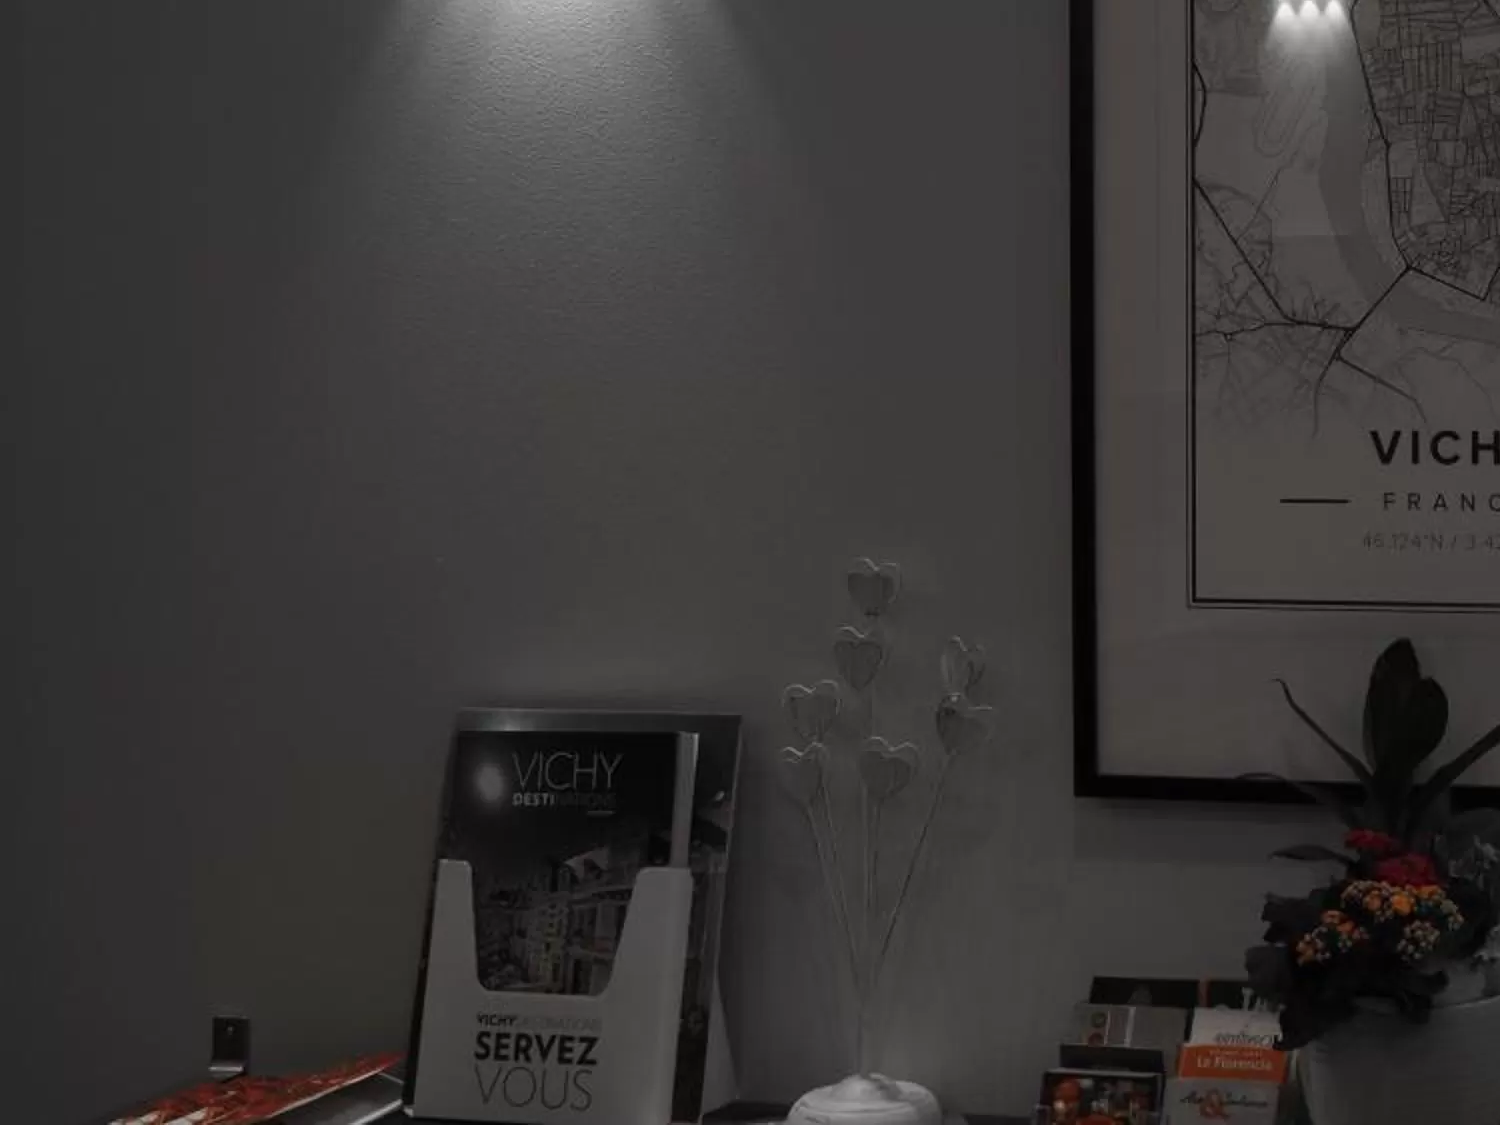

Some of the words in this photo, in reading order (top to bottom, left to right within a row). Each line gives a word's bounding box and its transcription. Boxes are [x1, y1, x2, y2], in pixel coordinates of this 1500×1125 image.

[511, 749, 625, 792] VICHY
[474, 1030, 599, 1066] SERVEZ
[475, 1064, 593, 1112] VOUS
